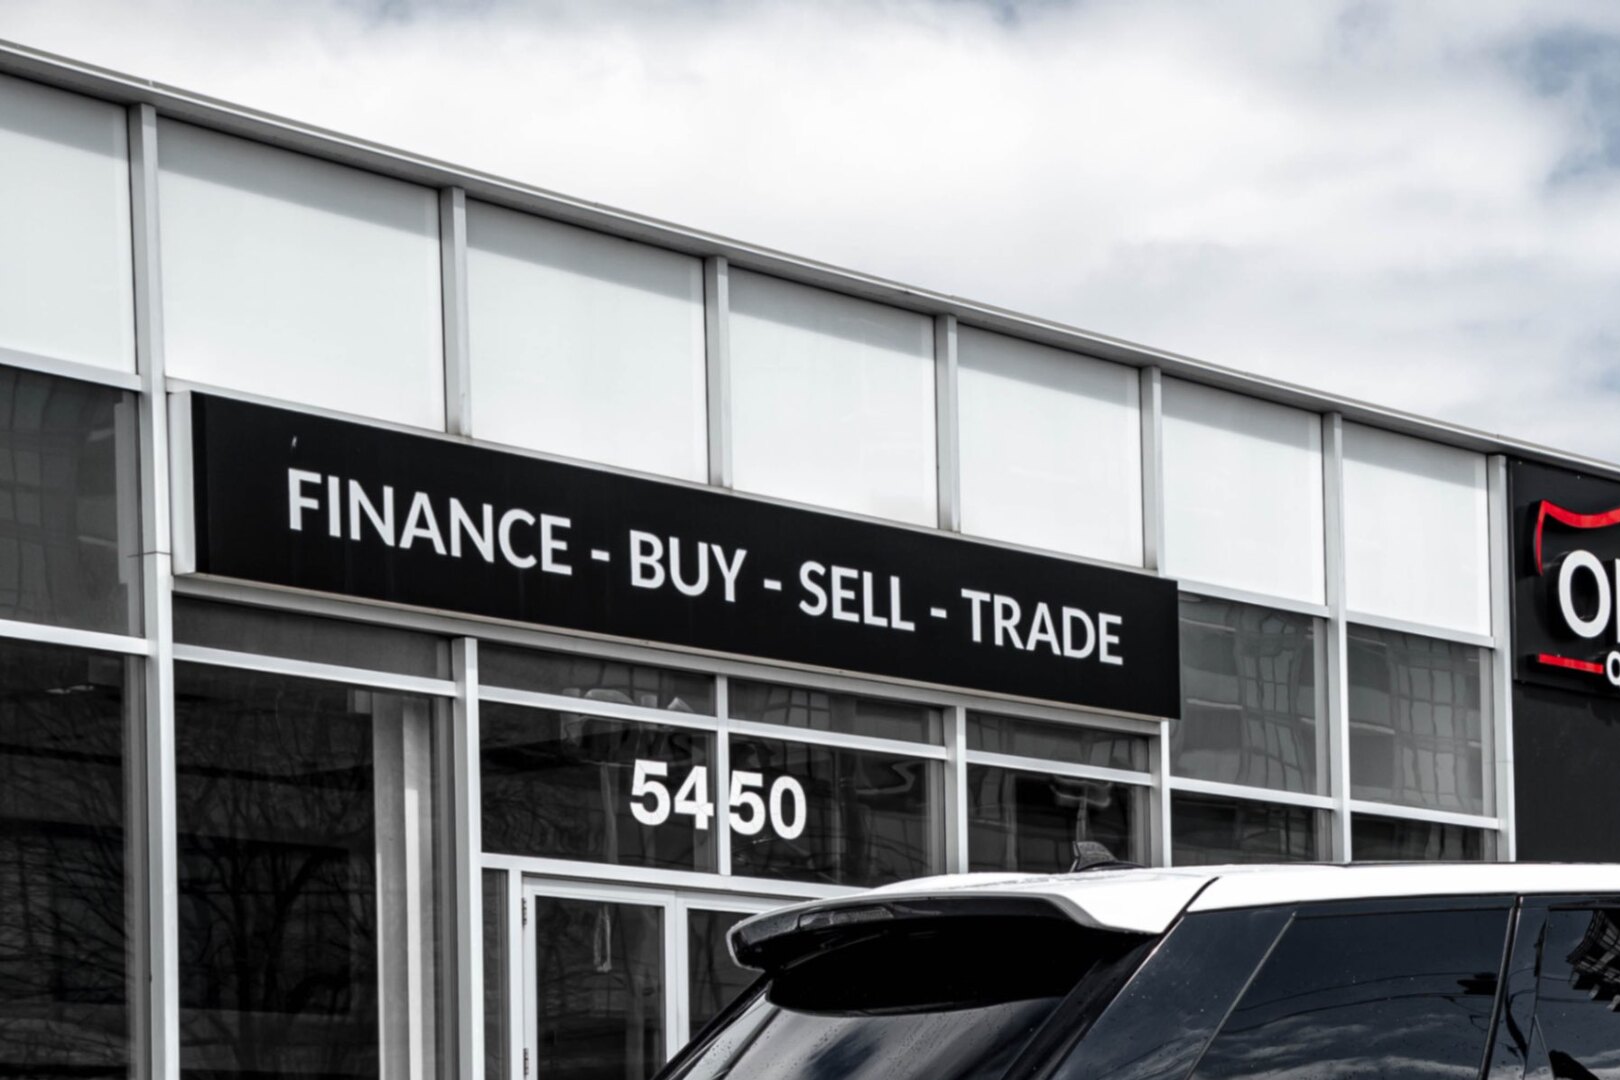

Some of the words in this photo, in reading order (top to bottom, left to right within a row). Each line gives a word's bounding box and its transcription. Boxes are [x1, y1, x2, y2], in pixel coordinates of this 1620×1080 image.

[286, 467, 574, 577] FINANCE
[628, 529, 749, 604] BUY
[798, 560, 917, 633] SELL
[959, 588, 1125, 667] TRADE
[629, 758, 808, 841] 5450
